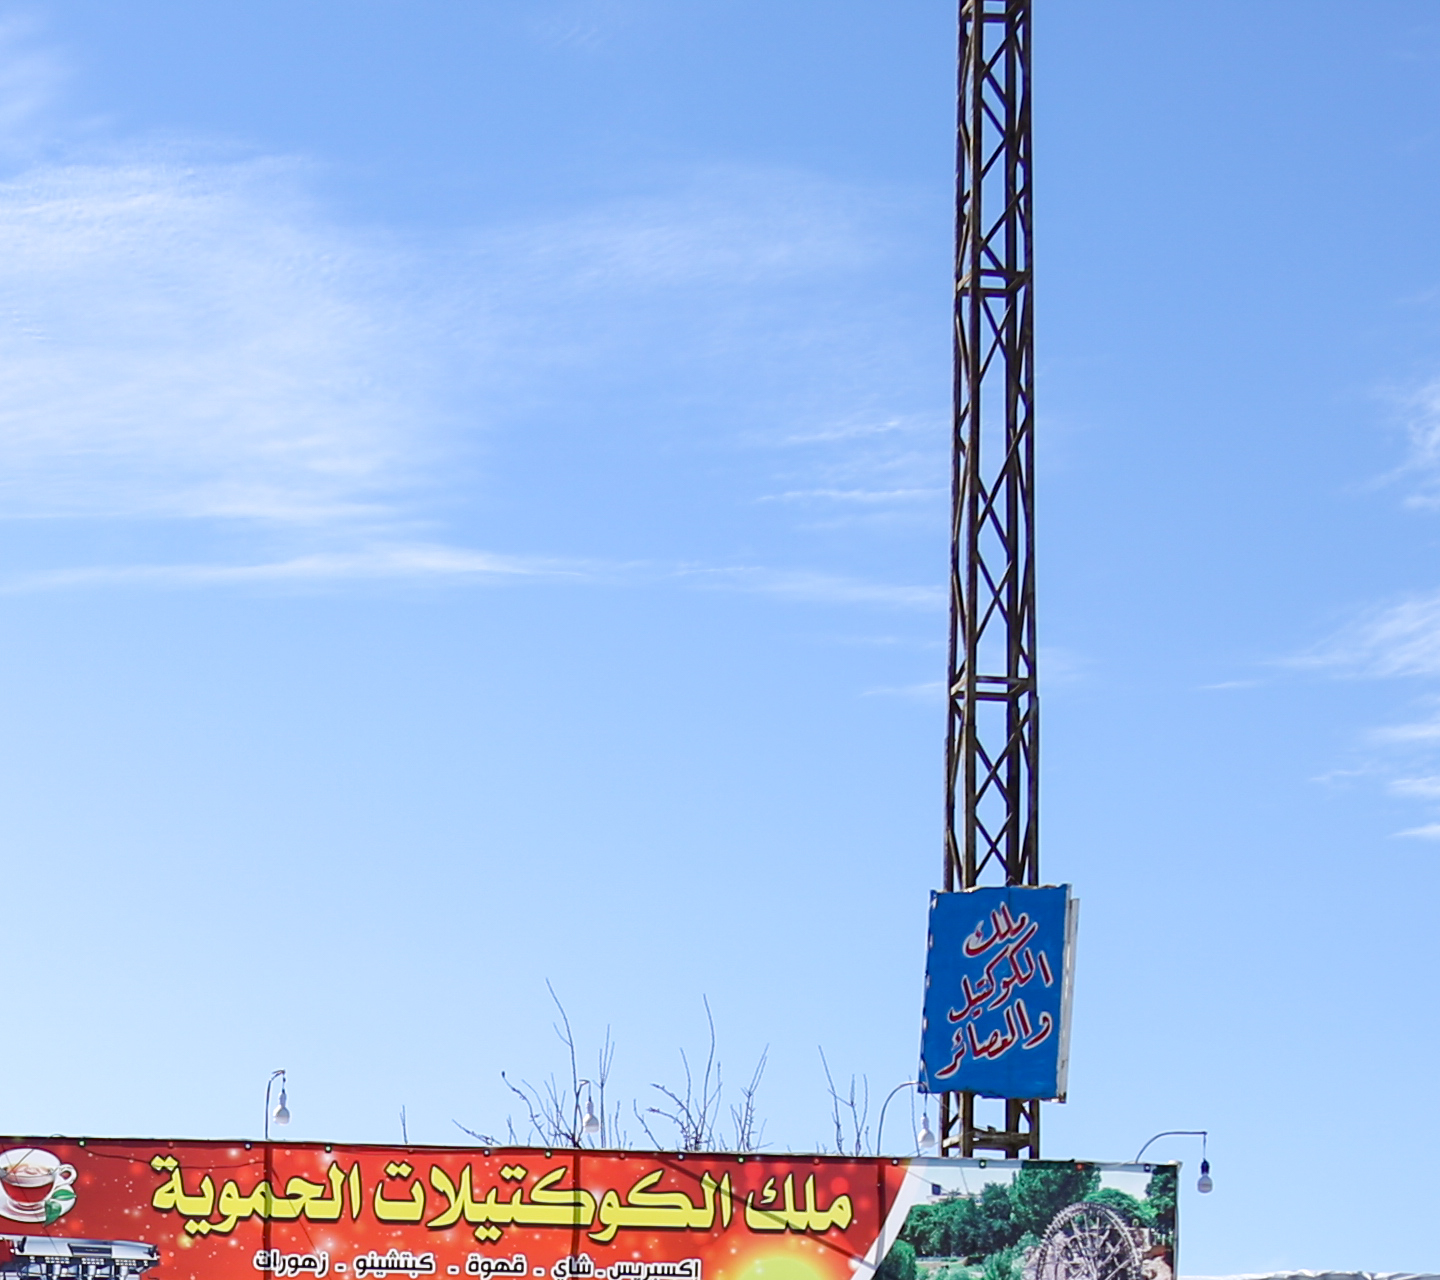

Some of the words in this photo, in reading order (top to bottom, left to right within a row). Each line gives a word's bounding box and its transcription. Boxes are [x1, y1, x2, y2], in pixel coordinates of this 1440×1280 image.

[963, 901, 1029, 957] ملك
[948, 923, 1053, 1022] الكوكتيل
[934, 999, 1052, 1079] والعصائر
[151, 1155, 362, 1235] الحموية
[374, 1161, 732, 1242] الكوكتيلات
[745, 1171, 854, 1232] ملك
[256, 1251, 327, 1275] زهورات
[356, 1250, 433, 1277] كبتشينو
[468, 1256, 525, 1278] قهوة
